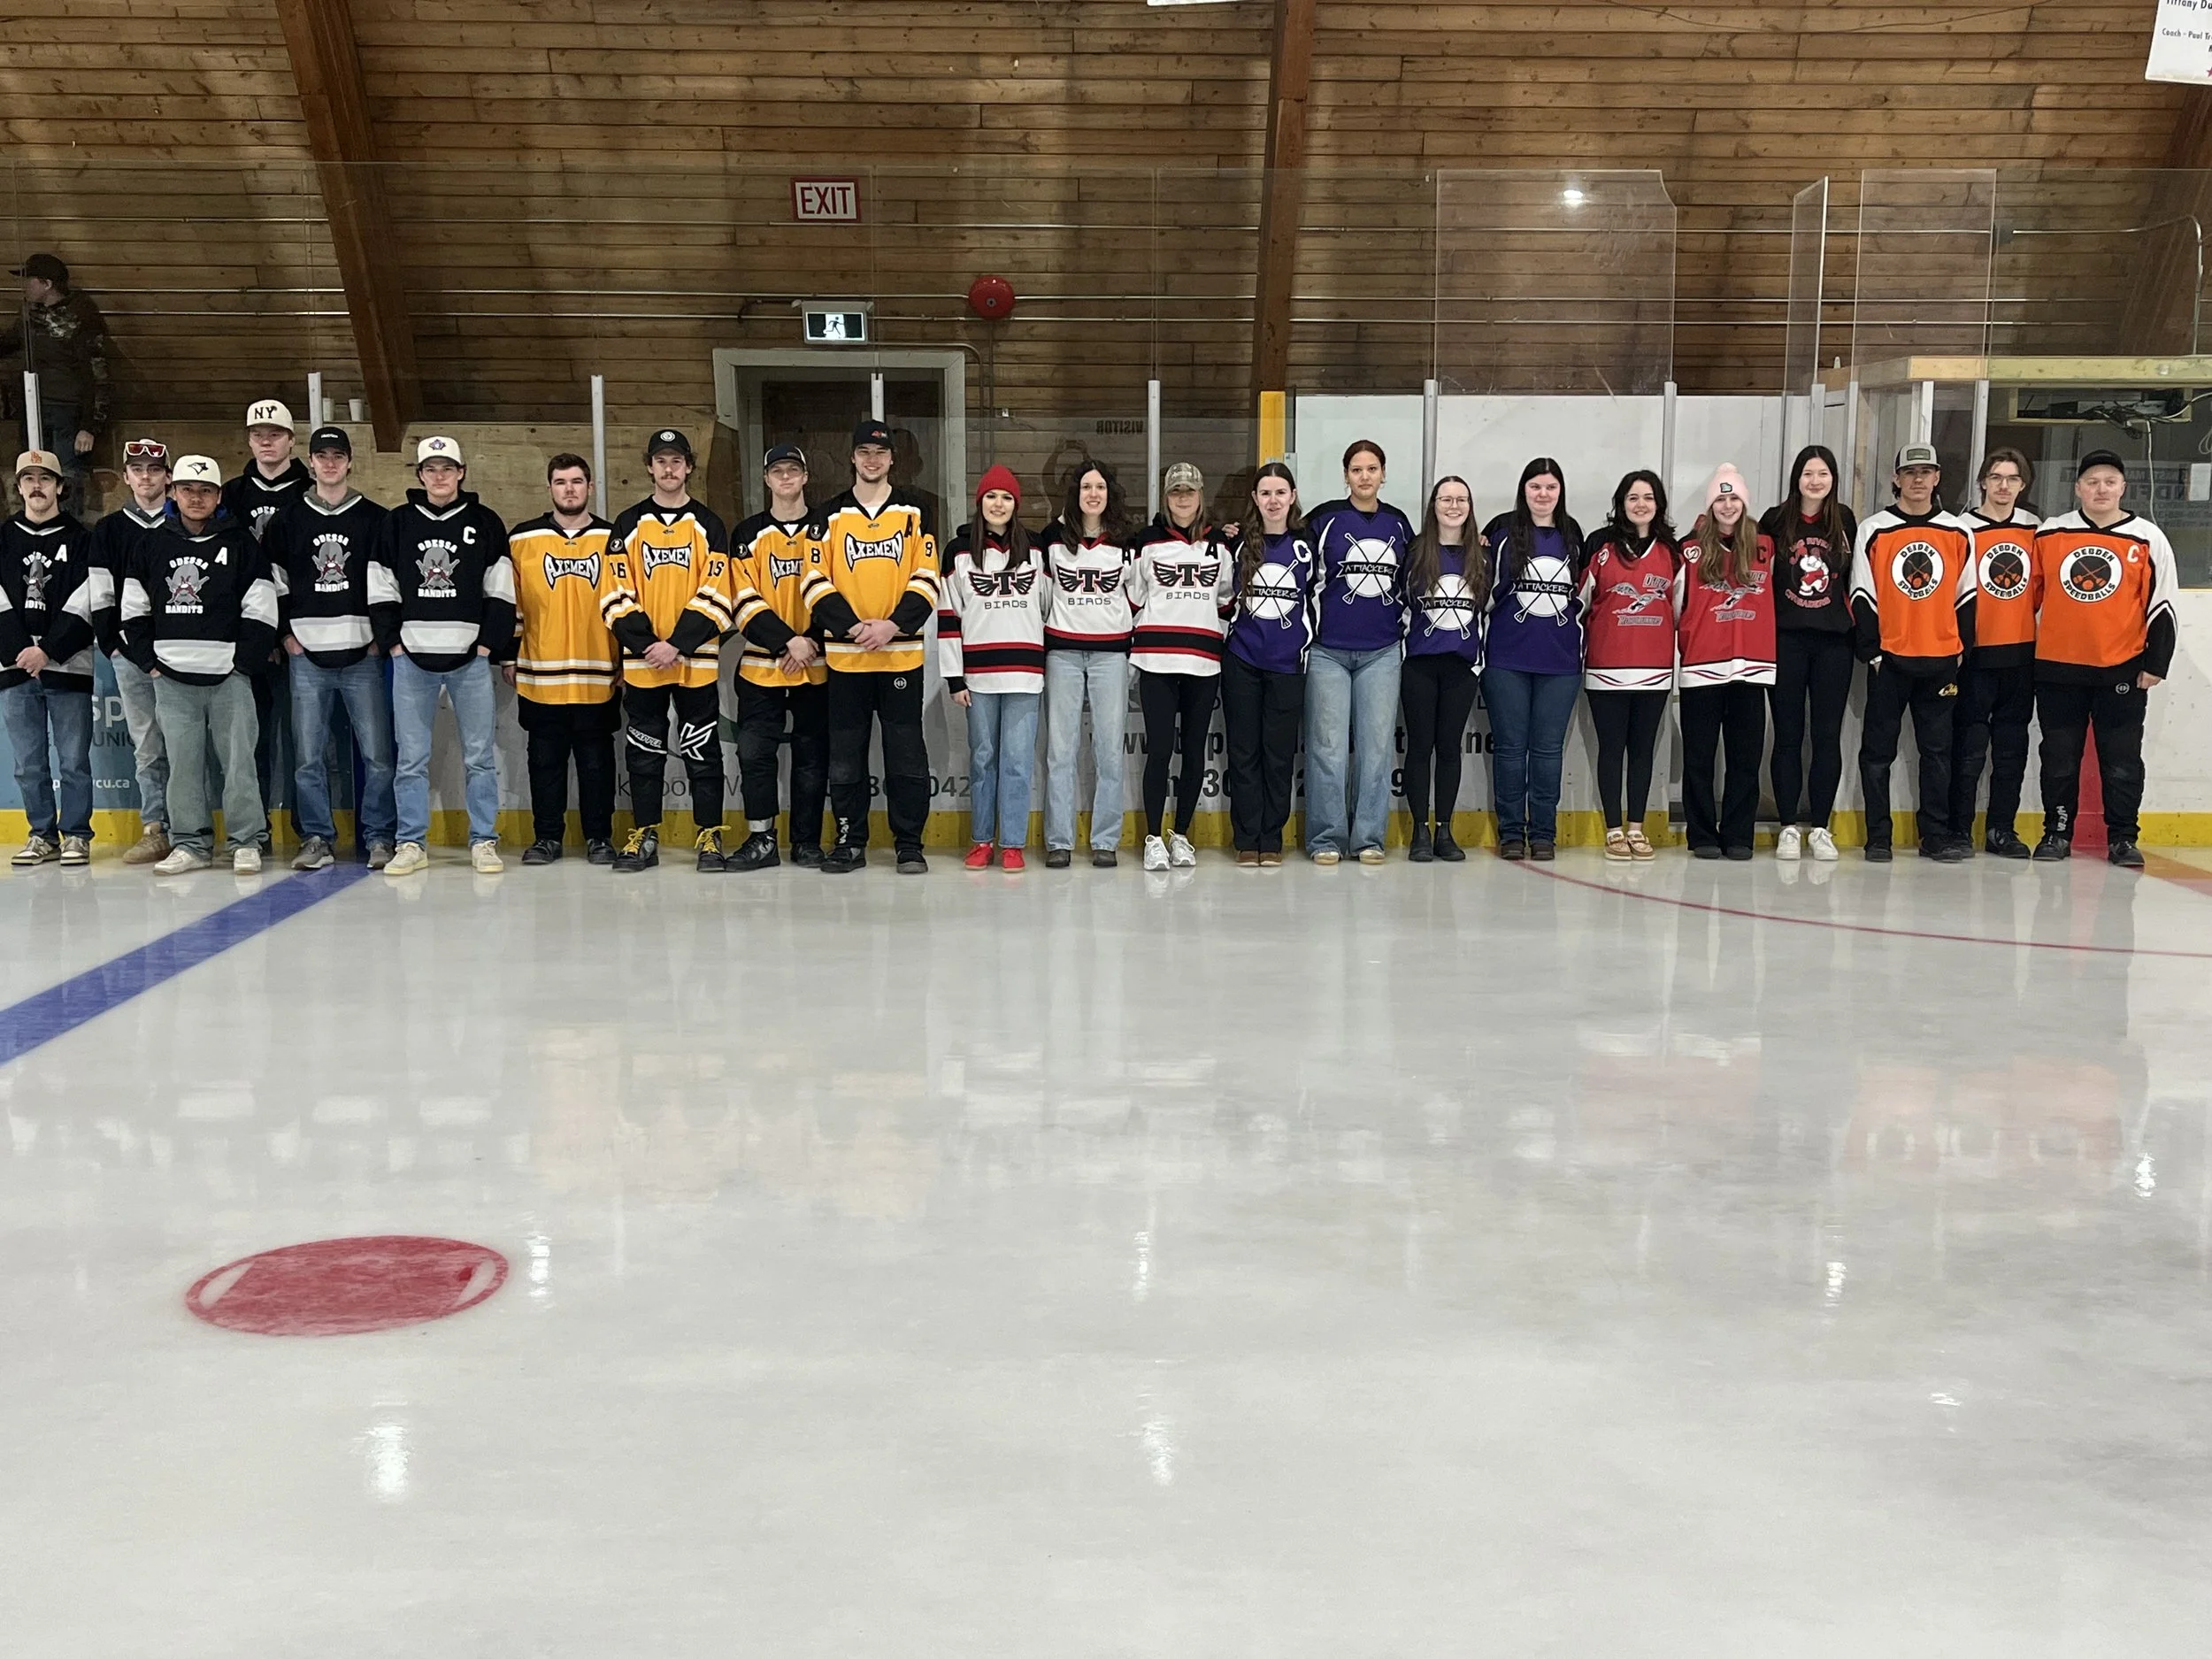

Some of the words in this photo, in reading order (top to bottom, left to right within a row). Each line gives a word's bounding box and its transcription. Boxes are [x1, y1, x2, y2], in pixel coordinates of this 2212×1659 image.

[800, 186, 851, 215] EXIT
[254, 406, 274, 420] NY
[312, 534, 349, 547] ODESSA
[463, 526, 477, 545] C
[55, 544, 68, 562] A
[214, 546, 227, 565] A
[418, 539, 458, 554] ODESSA
[845, 531, 903, 572] AXEMEN
[1204, 539, 1219, 560] A
[1293, 540, 1312, 563] C
[1985, 544, 2024, 560] DEBDEN
[2072, 548, 2116, 562] DEBDEN
[2126, 544, 2140, 563] C
[169, 556, 209, 571] ODESSA
[544, 552, 600, 590] AXEMEN
[770, 552, 804, 590] AXEM
[314, 580, 349, 593] BANDITS
[418, 588, 457, 598] BANDITS
[2062, 580, 2116, 601] SPEEDBALLS
[165, 604, 204, 614] BANDITS
